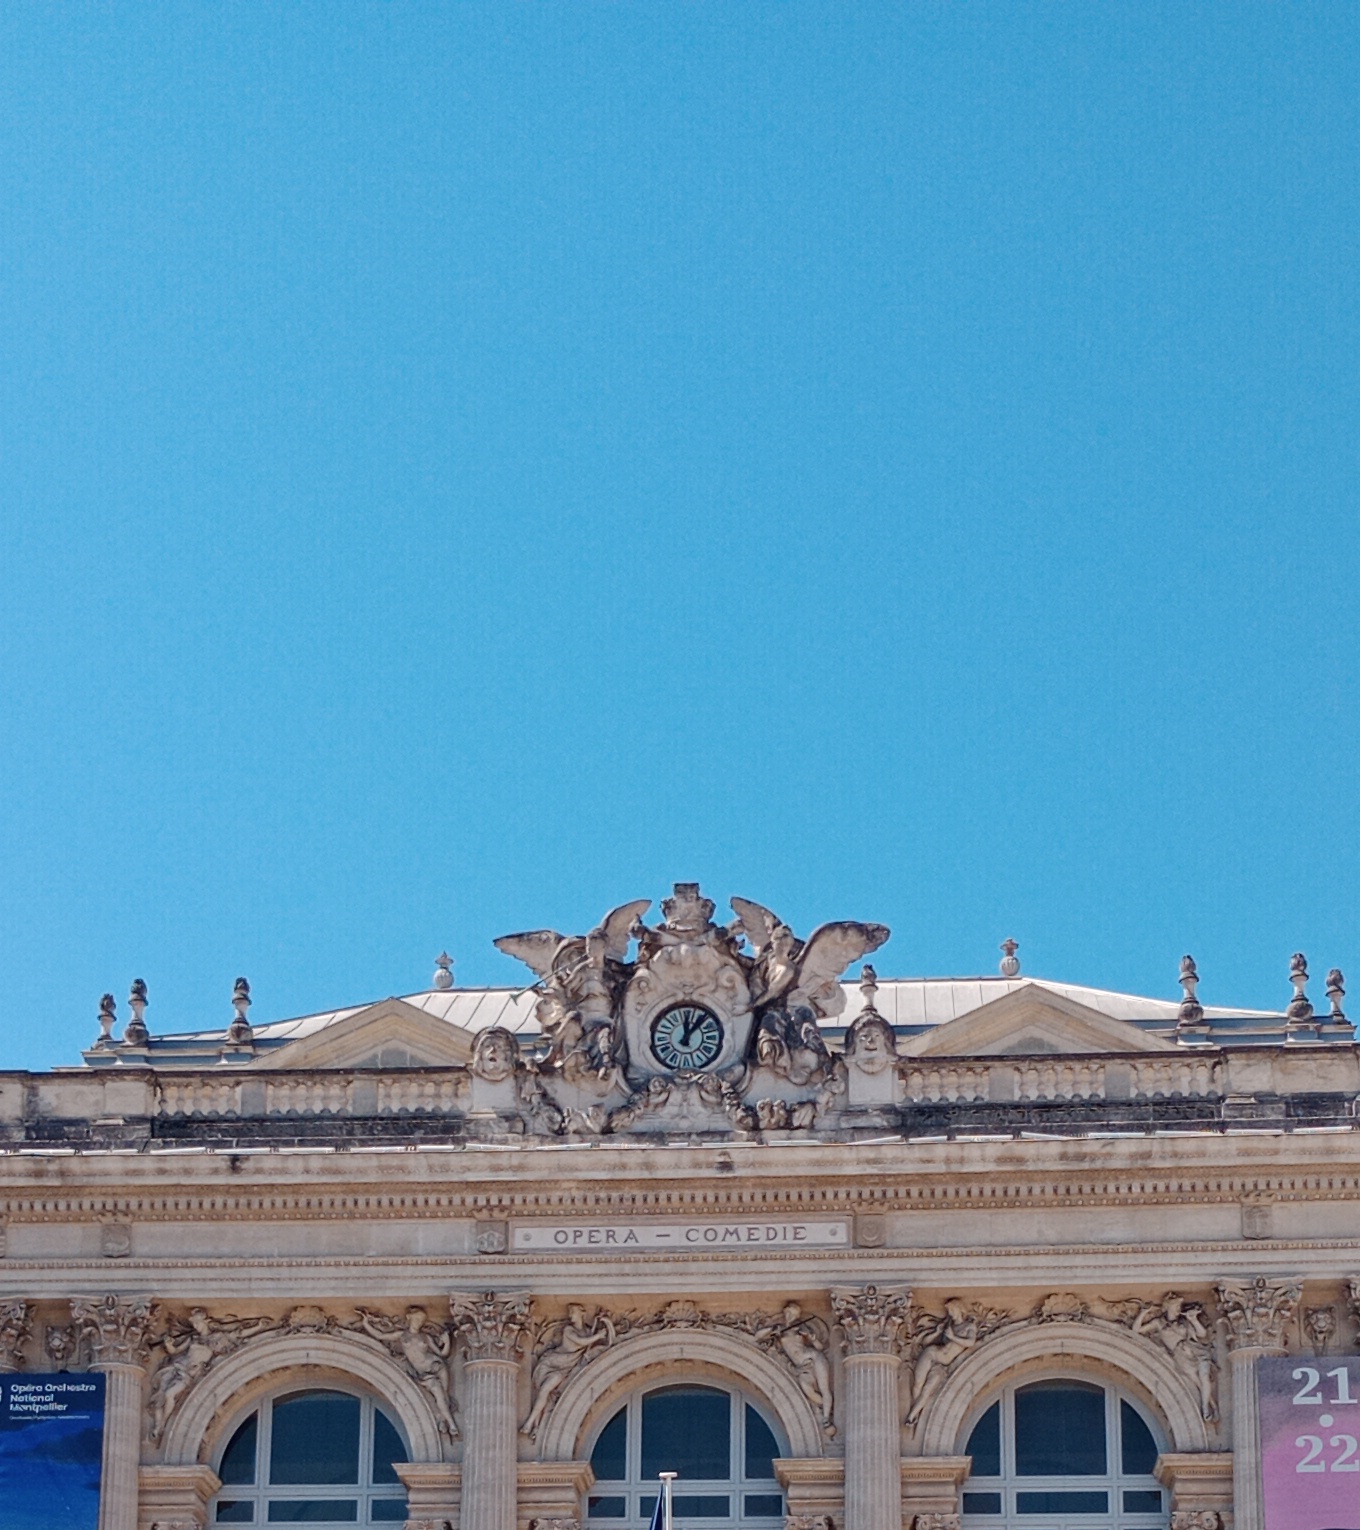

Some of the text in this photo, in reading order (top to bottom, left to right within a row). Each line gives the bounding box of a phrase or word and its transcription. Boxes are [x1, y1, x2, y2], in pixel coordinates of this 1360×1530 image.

[553, 1229, 639, 1244] OPERA
[685, 1226, 808, 1242] COMEDIE
[10, 1382, 97, 1394] Opéra Orchestre
[1292, 1366, 1358, 1405] 21
[10, 1393, 54, 1402] National
[9, 1402, 68, 1413] Montpellier
[1295, 1433, 1360, 1473] 22
